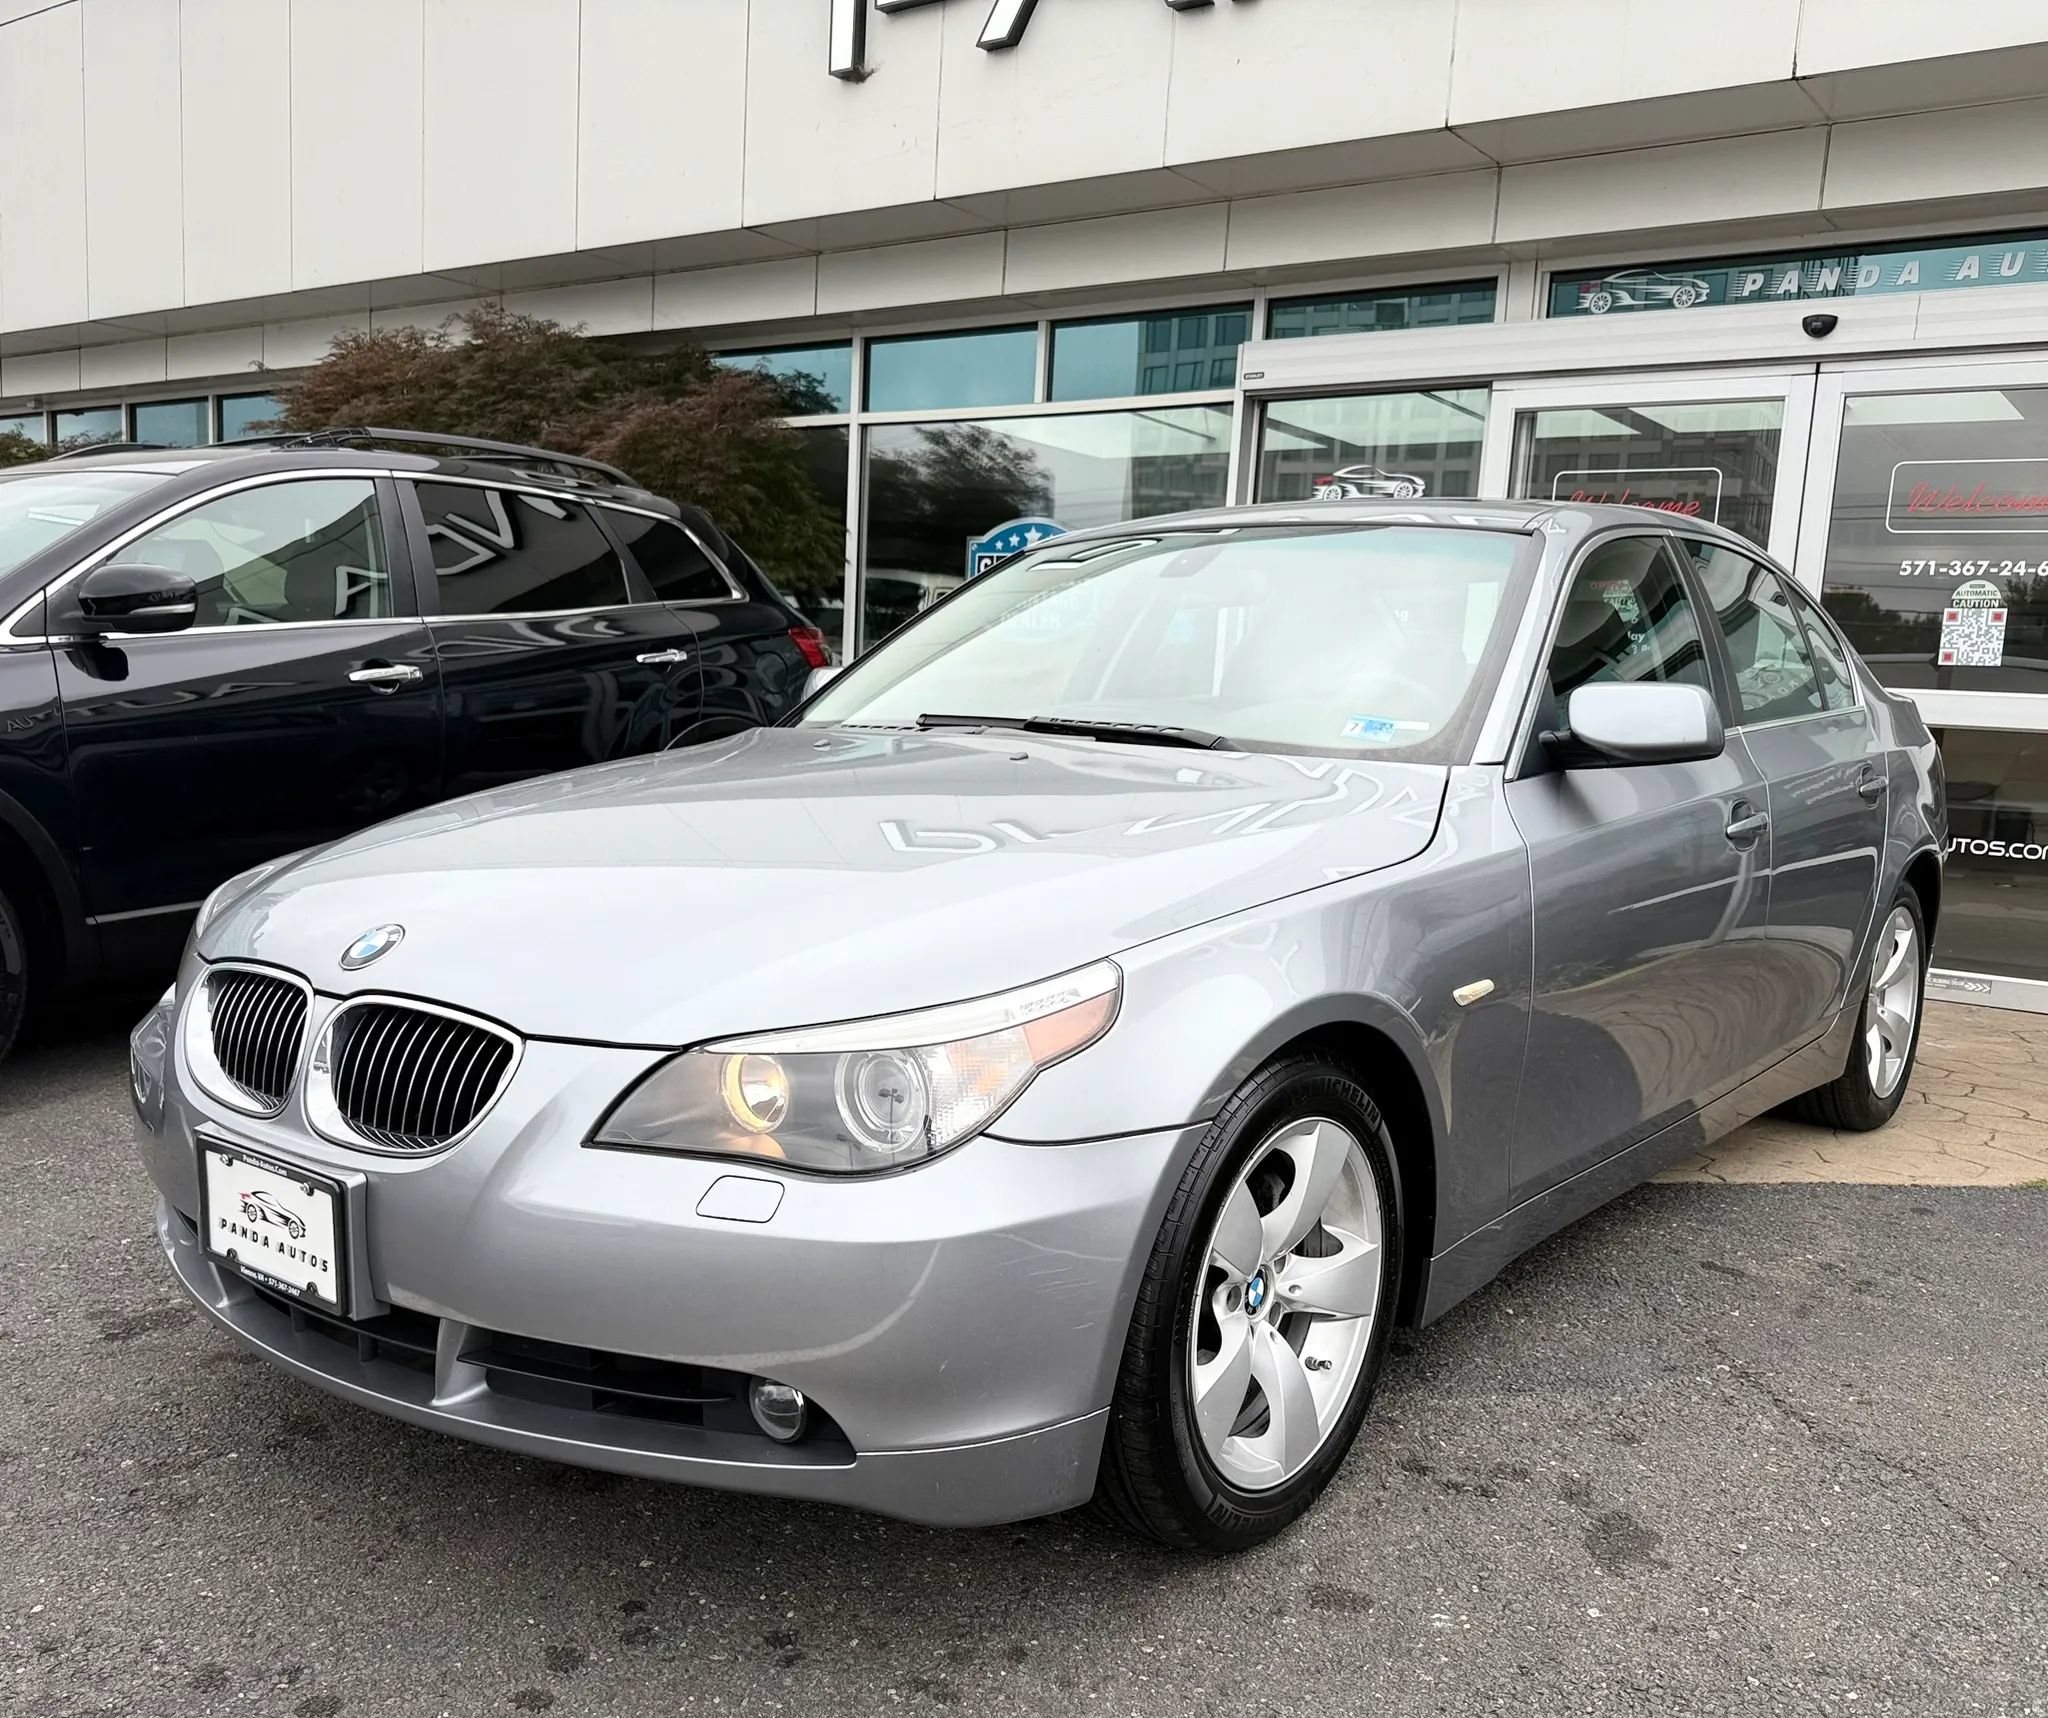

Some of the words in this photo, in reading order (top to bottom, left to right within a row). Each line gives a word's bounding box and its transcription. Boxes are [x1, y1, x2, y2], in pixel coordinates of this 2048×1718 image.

[1729, 260, 1920, 297] PANDA
[1952, 599, 1999, 608] CAUTION
[219, 1217, 270, 1249] PANDA
[276, 1241, 329, 1273] AUTOS
